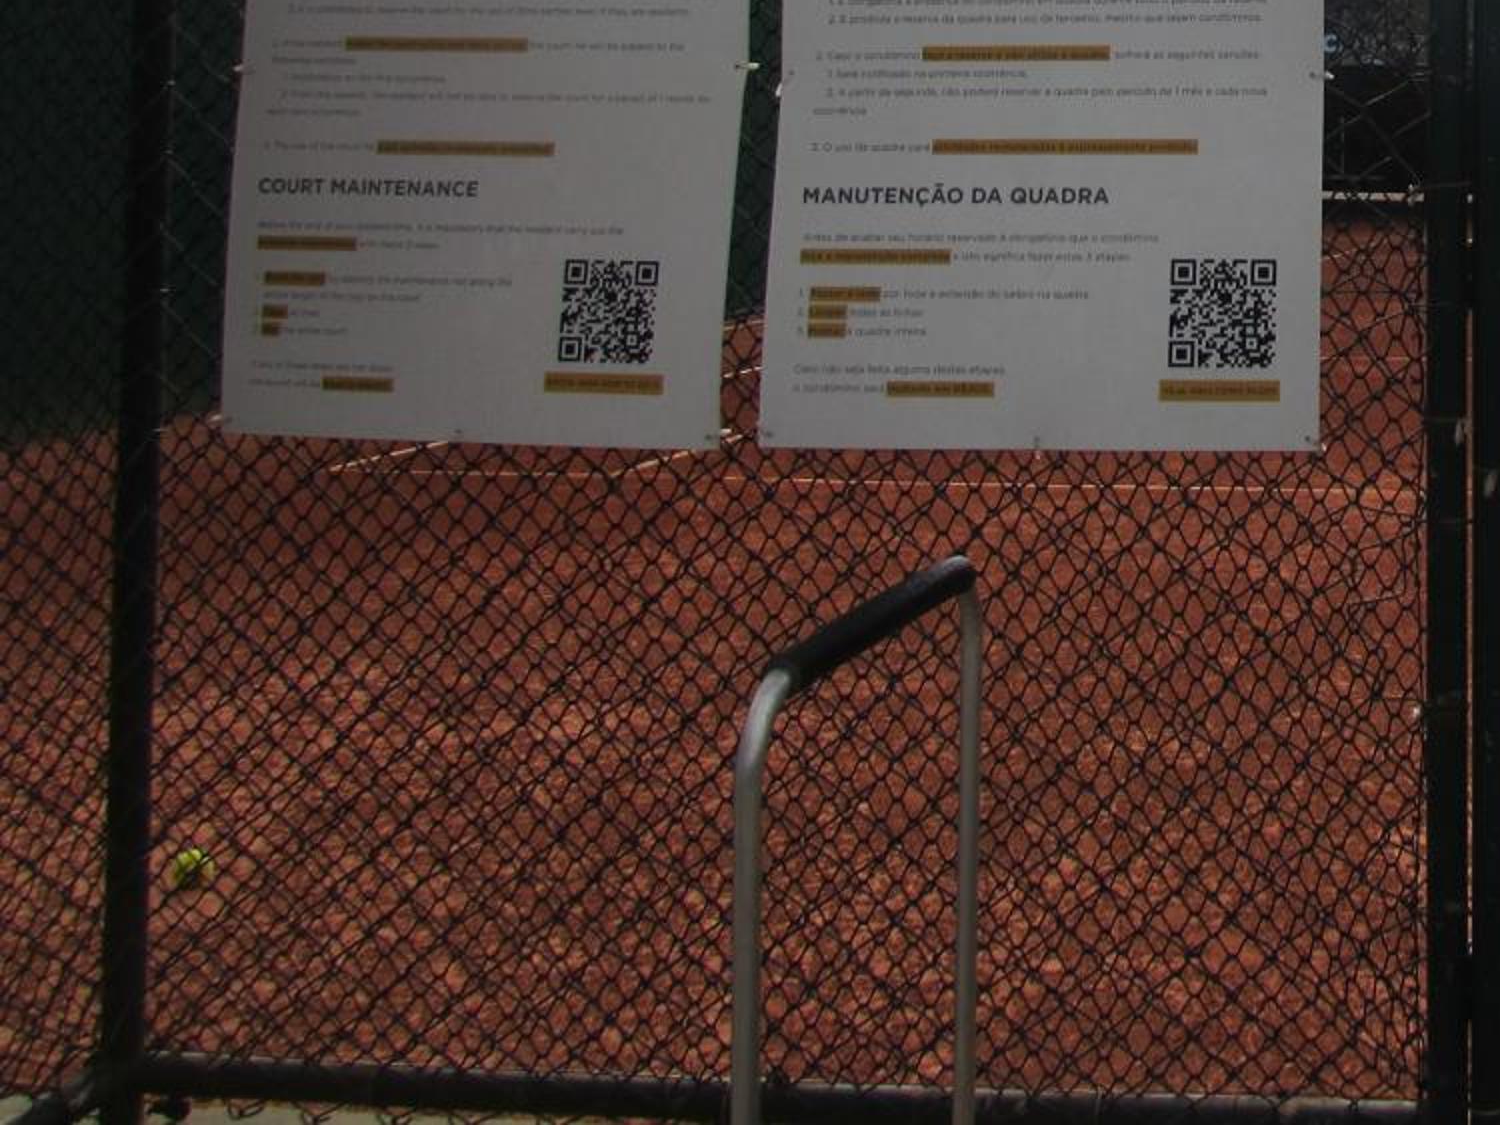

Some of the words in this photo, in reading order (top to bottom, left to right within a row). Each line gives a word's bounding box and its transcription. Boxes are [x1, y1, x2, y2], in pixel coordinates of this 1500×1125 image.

[257, 177, 326, 197] COURT
[330, 178, 480, 198] MAINTENANCE
[802, 182, 964, 208] MANUTENÇÃO
[971, 186, 1003, 204] DA
[1010, 186, 1109, 205] QUADRA
